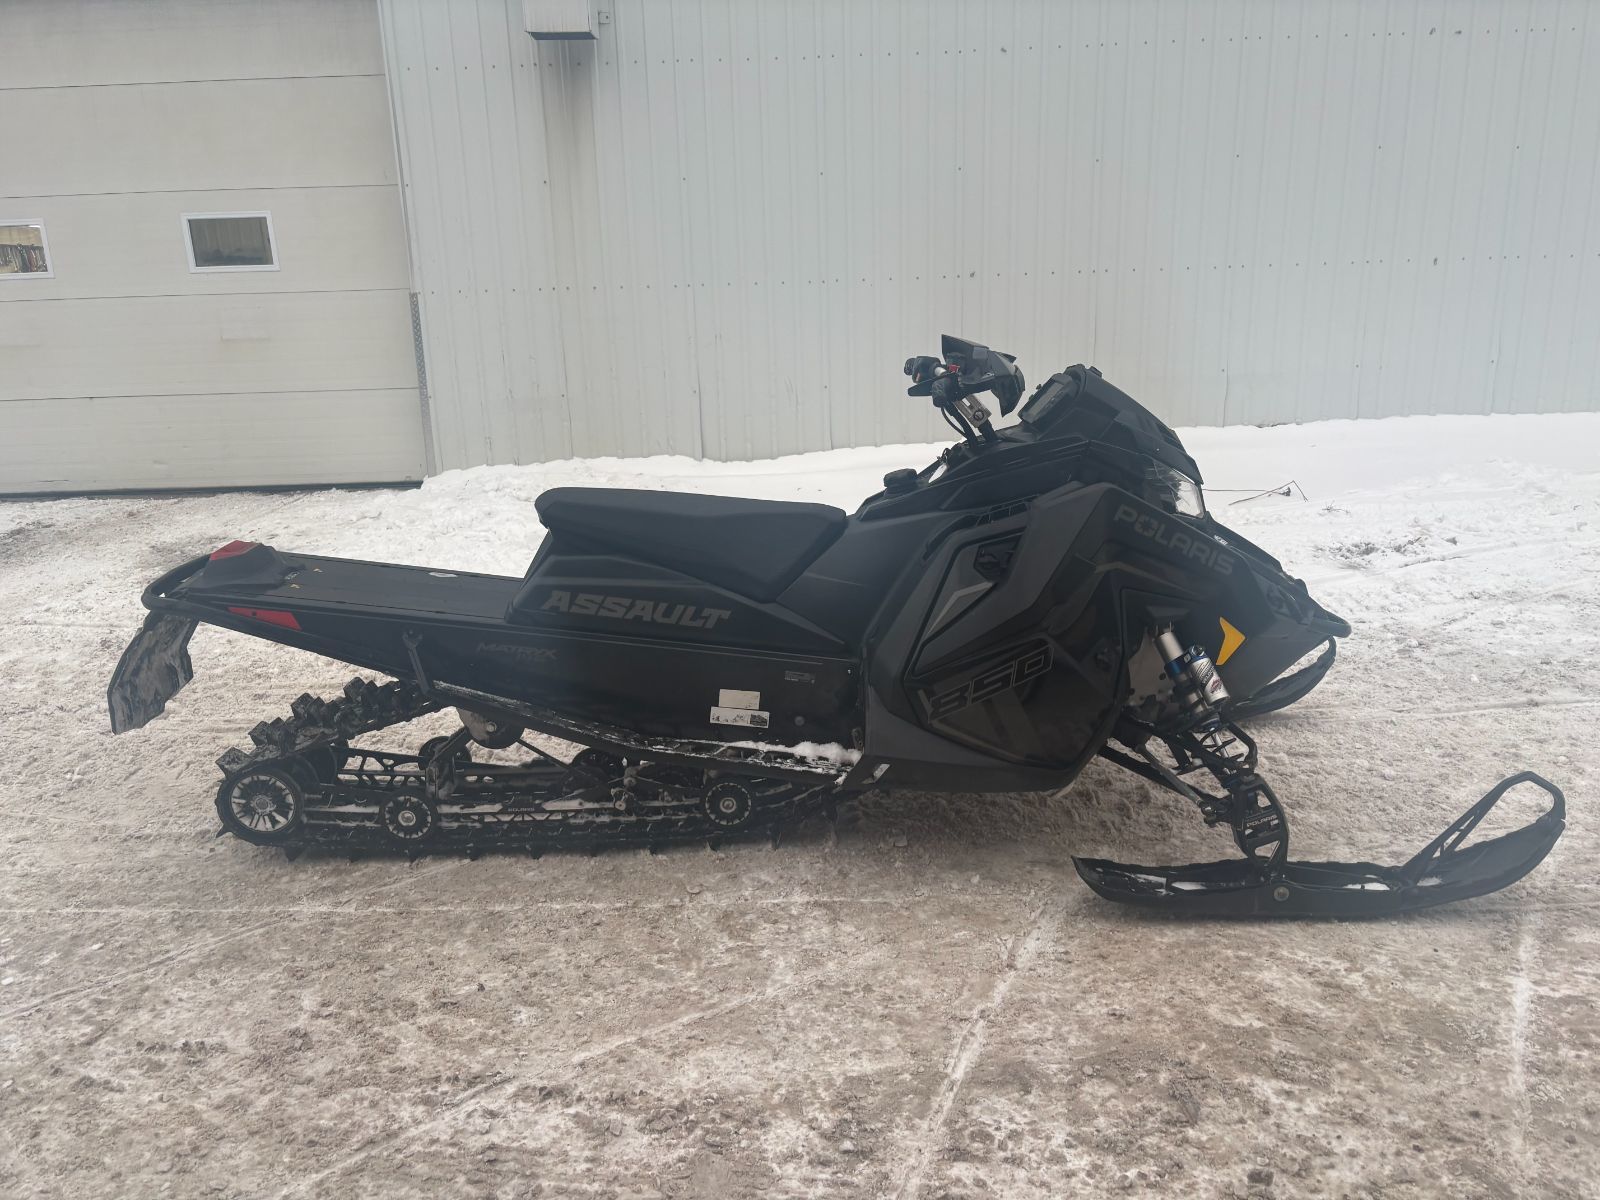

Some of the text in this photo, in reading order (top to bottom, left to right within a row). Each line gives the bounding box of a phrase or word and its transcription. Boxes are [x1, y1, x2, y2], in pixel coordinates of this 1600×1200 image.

[1113, 504, 1234, 575] POLARIS
[543, 591, 731, 629] ASSAULT
[477, 643, 558, 662] MATRYX
[928, 644, 1055, 723] 850
